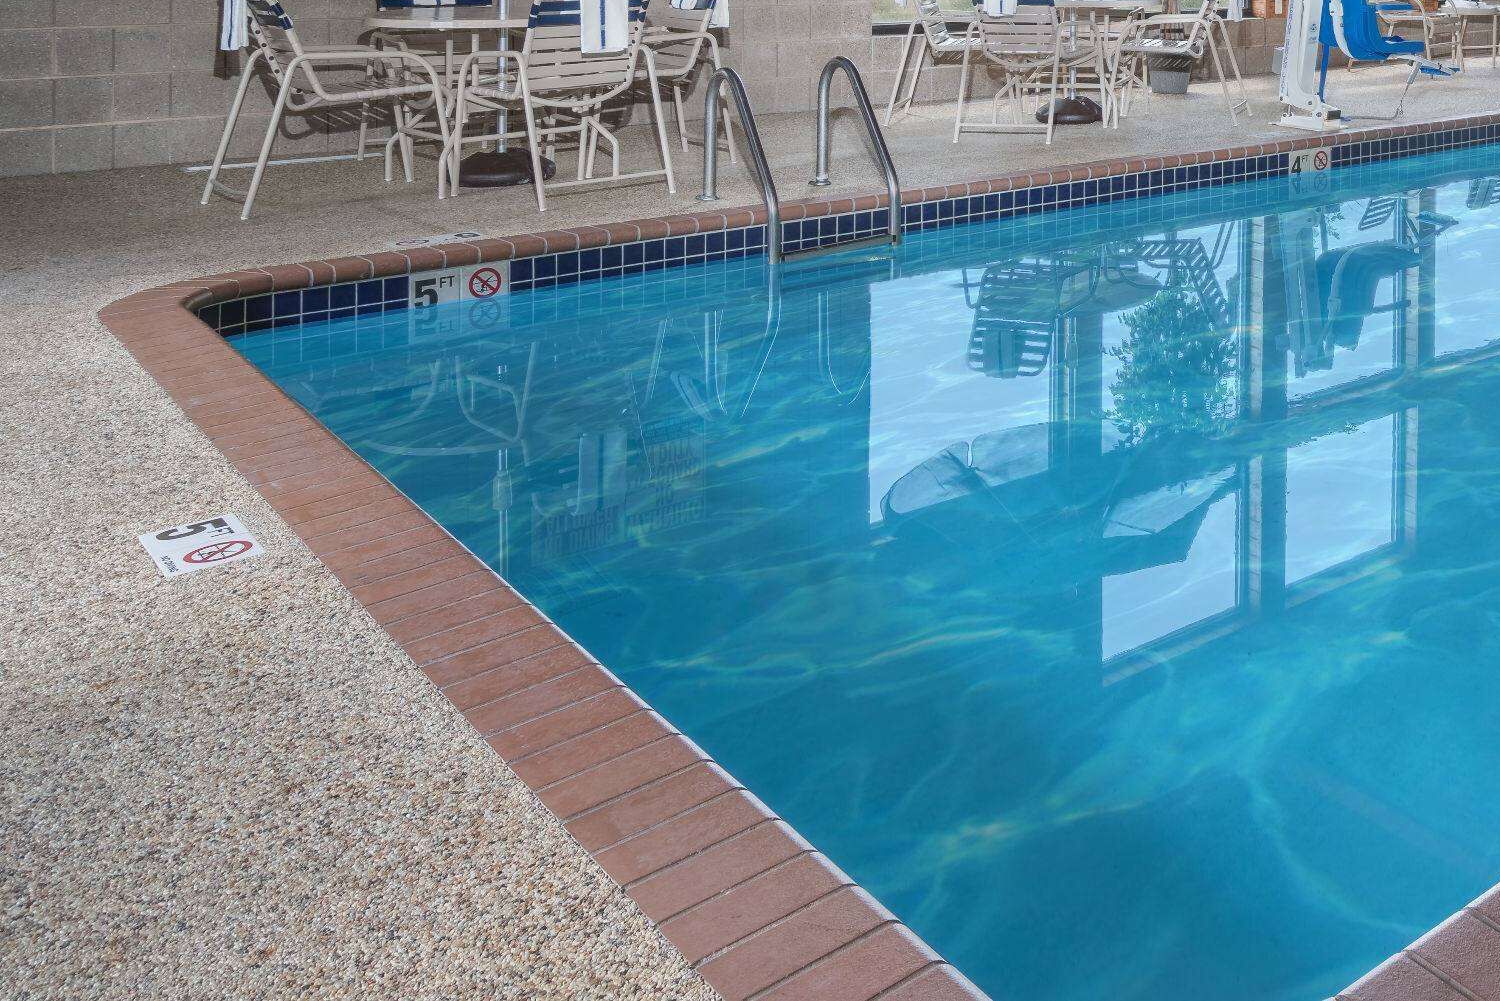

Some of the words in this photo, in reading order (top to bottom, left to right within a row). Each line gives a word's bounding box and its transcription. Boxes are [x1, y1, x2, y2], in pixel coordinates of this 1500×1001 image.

[1291, 155, 1302, 173] 4
[414, 278, 438, 309] 5
[440, 276, 455, 288] FT
[156, 517, 228, 540] 5
